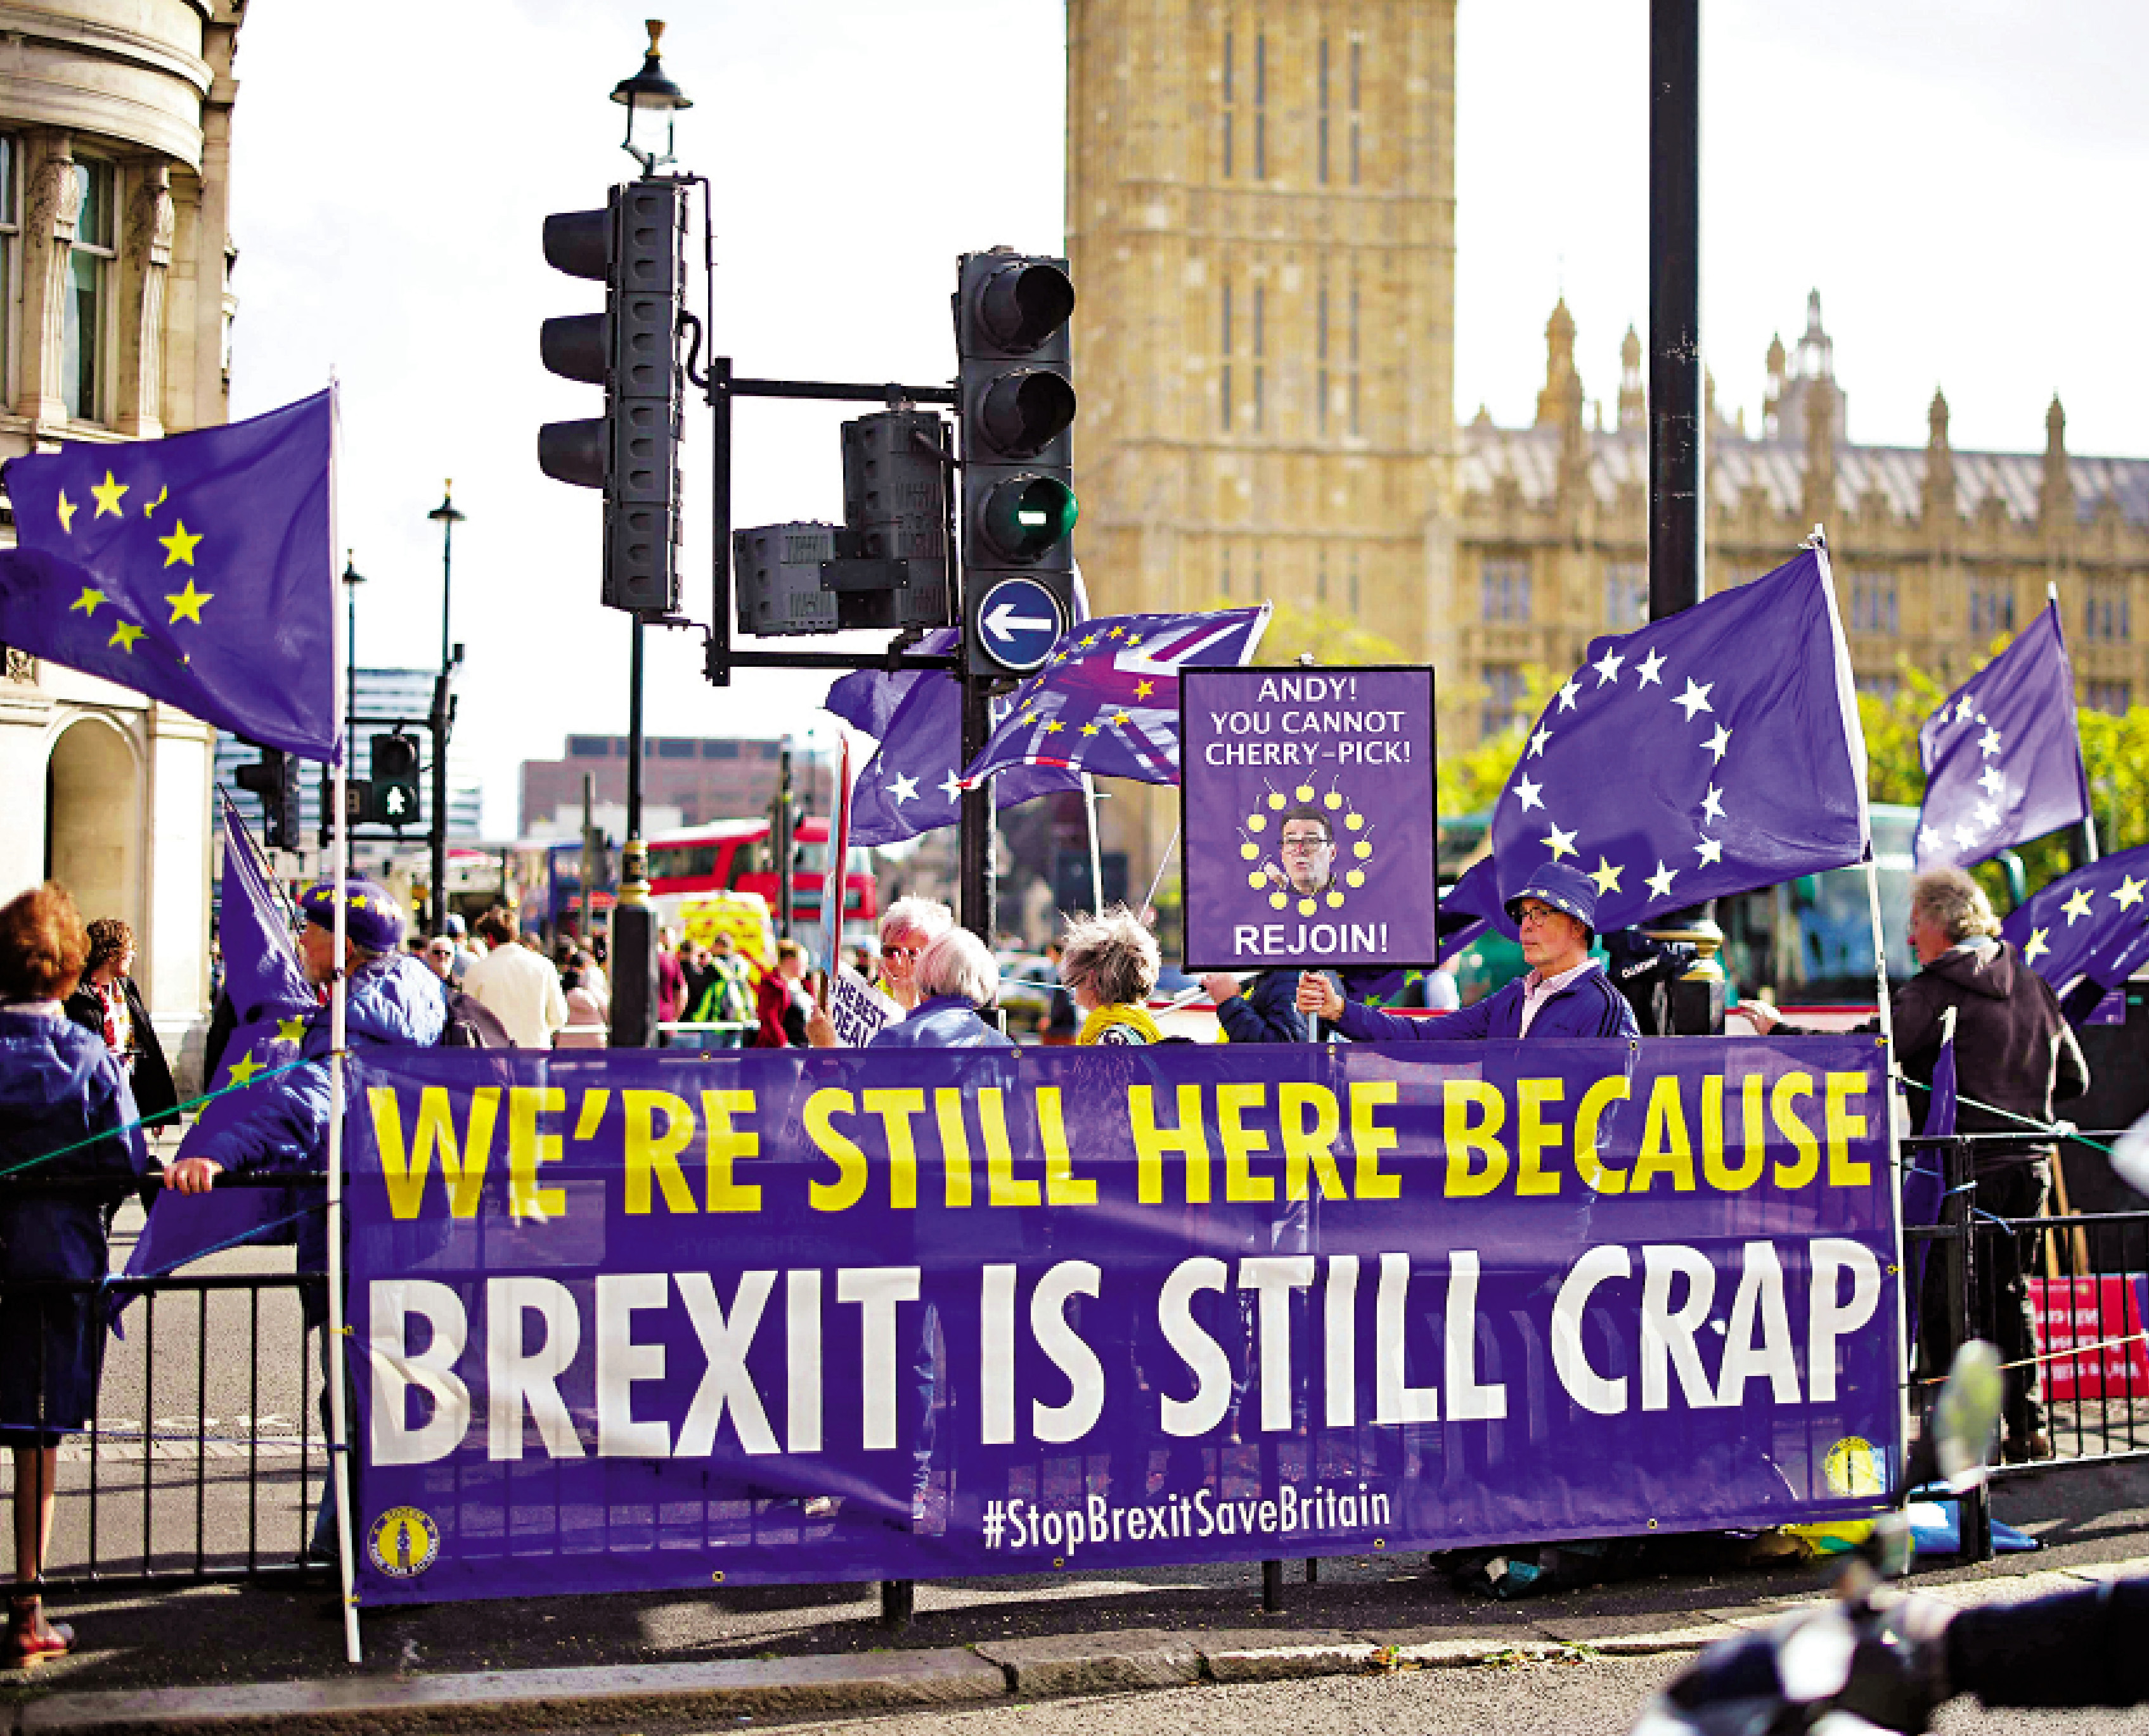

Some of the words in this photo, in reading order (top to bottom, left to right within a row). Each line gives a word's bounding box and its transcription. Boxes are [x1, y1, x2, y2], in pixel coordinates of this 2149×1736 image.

[1258, 678, 1357, 702] ANDY!
[1211, 711, 1270, 735] YOU
[1282, 710, 1407, 734] CANNOT
[1205, 741, 1410, 765] CHERRY-PICK!
[1234, 923, 1388, 955] REJOIN!
[854, 992, 887, 1029] BEST
[803, 1086, 1099, 1212] STILL
[1128, 1081, 1402, 1204] HERE
[1443, 1071, 1871, 1198] BECAUSE
[369, 1266, 921, 1467] BREXIT
[981, 1260, 1105, 1444] IS
[1158, 1250, 1507, 1437] STILL
[1551, 1237, 1881, 1415] CRAP
[983, 1483, 1391, 1556] #StopBrexitSaveBritain
